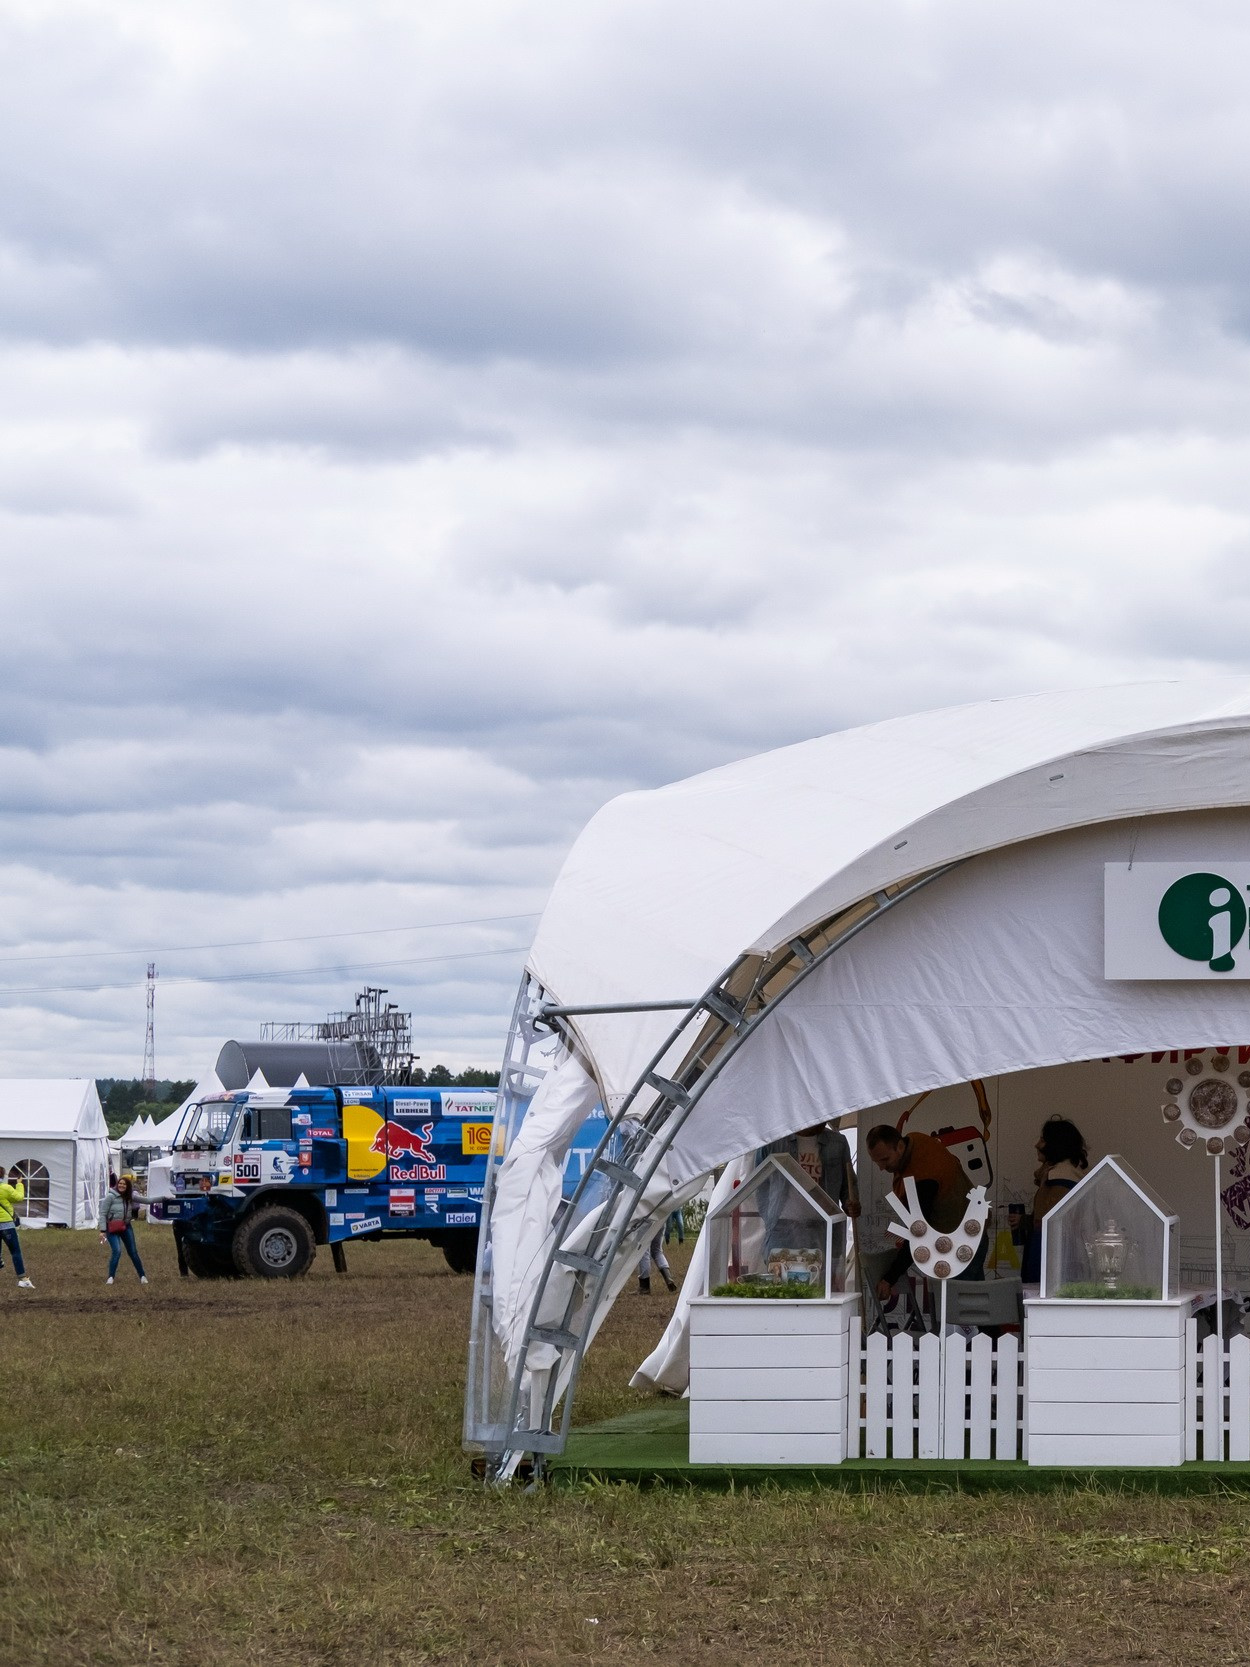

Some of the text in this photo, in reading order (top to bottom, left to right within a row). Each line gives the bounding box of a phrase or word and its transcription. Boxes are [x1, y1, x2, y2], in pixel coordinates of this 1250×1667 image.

[236, 1164, 259, 1178] 500
[390, 1164, 446, 1180] Red Bull
[448, 1213, 475, 1223] Haier
[359, 1220, 380, 1229] VARTA
